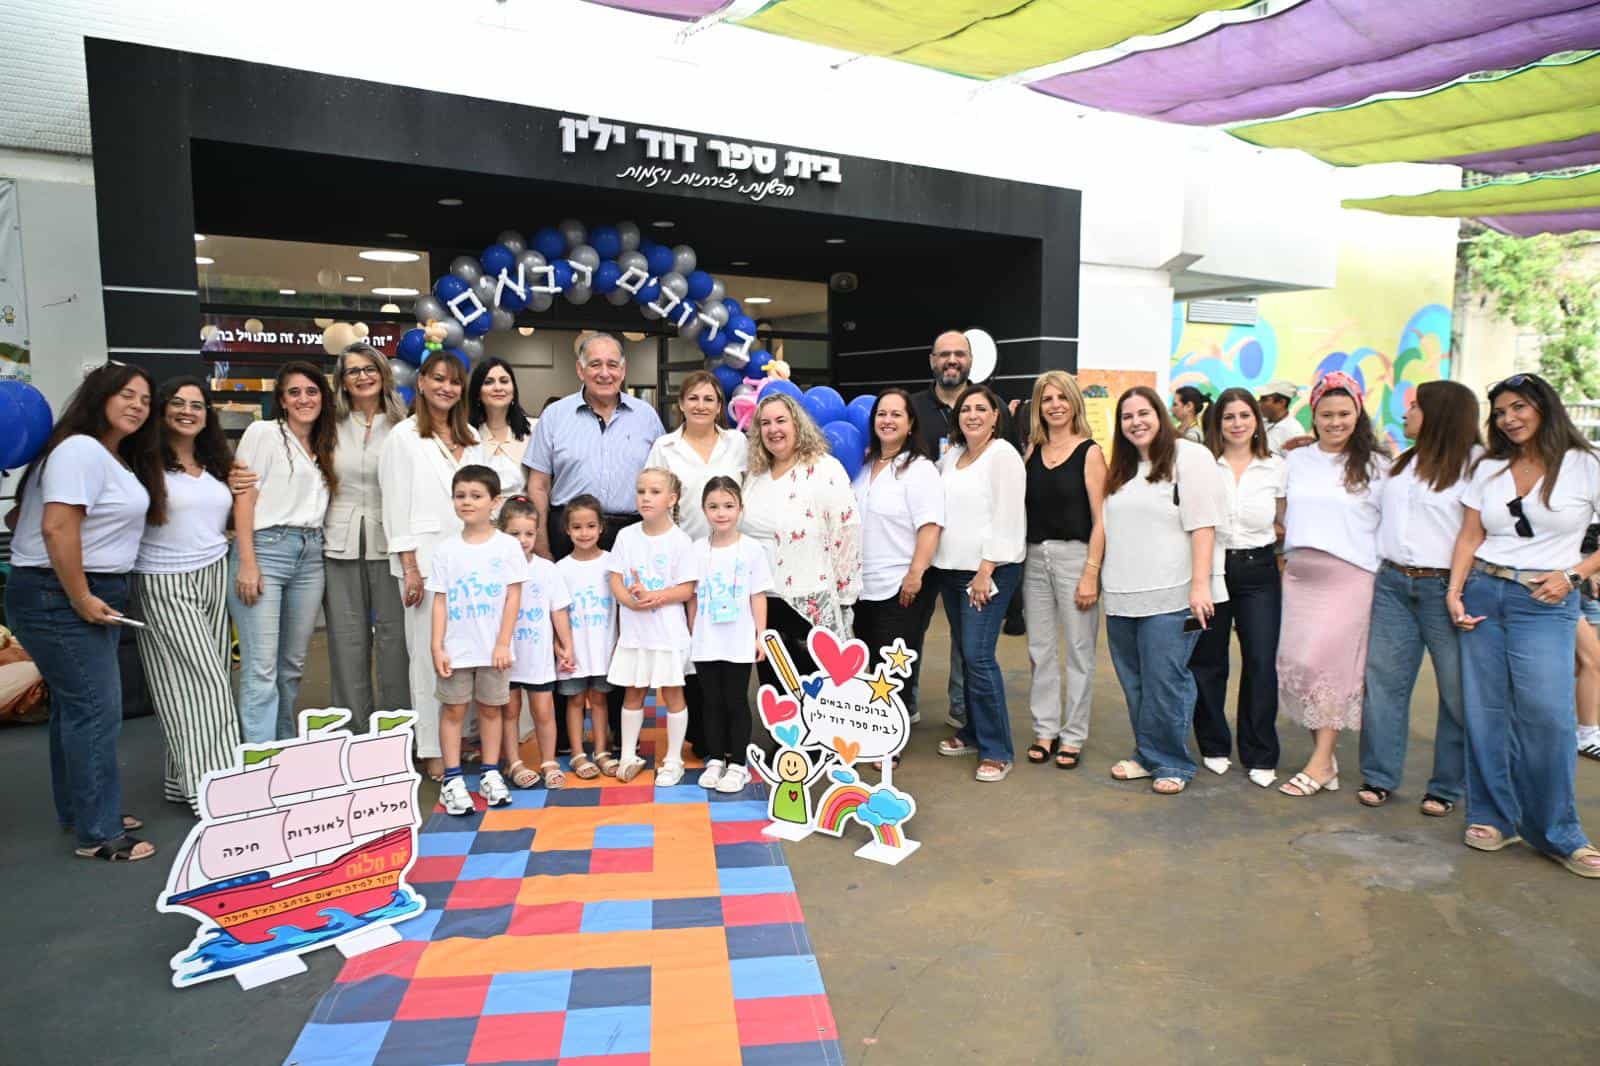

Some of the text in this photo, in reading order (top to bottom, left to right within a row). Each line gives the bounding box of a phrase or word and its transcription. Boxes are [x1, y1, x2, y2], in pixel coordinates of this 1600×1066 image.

[559, 115, 842, 183] בית ספר דוד ילין
[616, 165, 672, 188] ויזמות
[672, 172, 738, 189] יצירתיות
[447, 259, 754, 361] ברוכים הבאים
[820, 697, 889, 718] ברוכים הבאים
[810, 709, 898, 735] לבית ספר דוד ילין
[222, 800, 408, 858] מפליגים לאוצרות חיפה
[224, 912, 249, 924] חיפה
